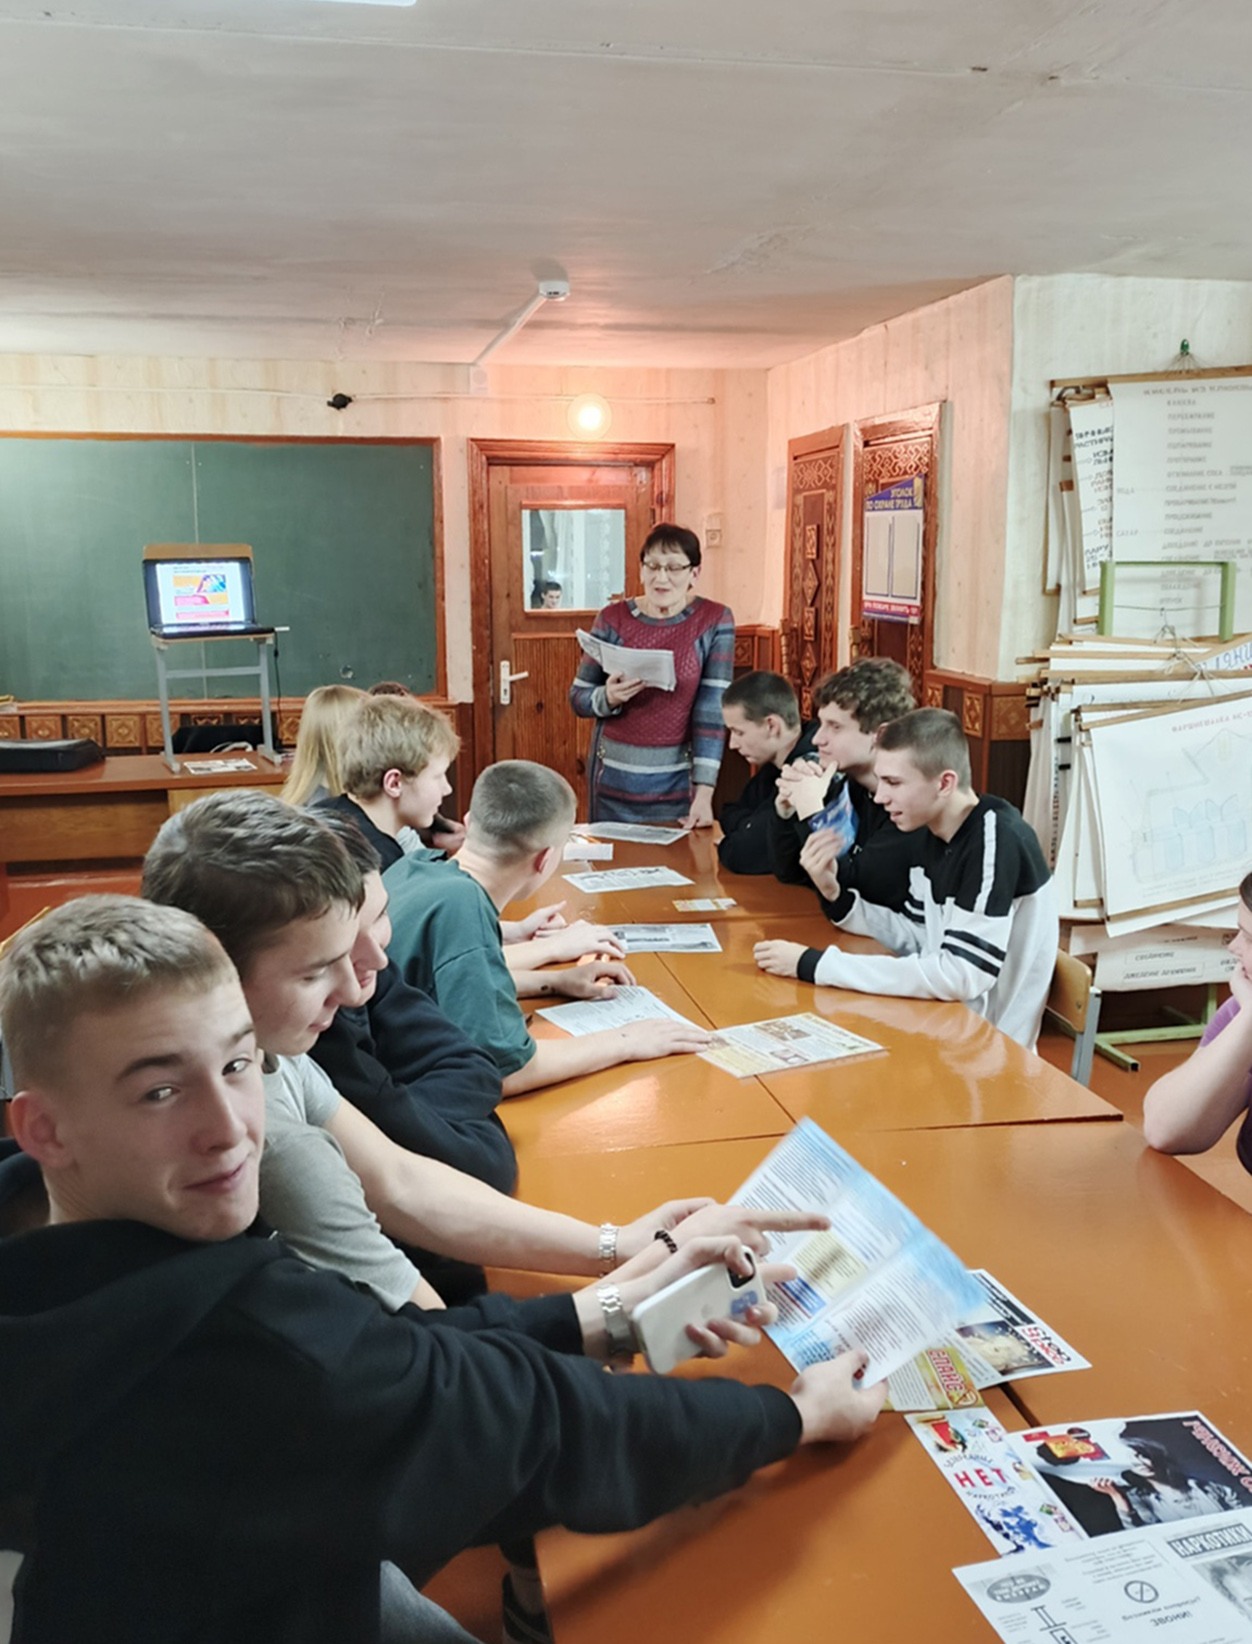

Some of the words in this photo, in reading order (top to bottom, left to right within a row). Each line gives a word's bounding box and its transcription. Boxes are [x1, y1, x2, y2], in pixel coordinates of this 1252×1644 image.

[926, 1348, 965, 1392] СПАЙС
[954, 1466, 1007, 1488] НЕТ
[1170, 1525, 1252, 1556] НАРКОТИКИ
